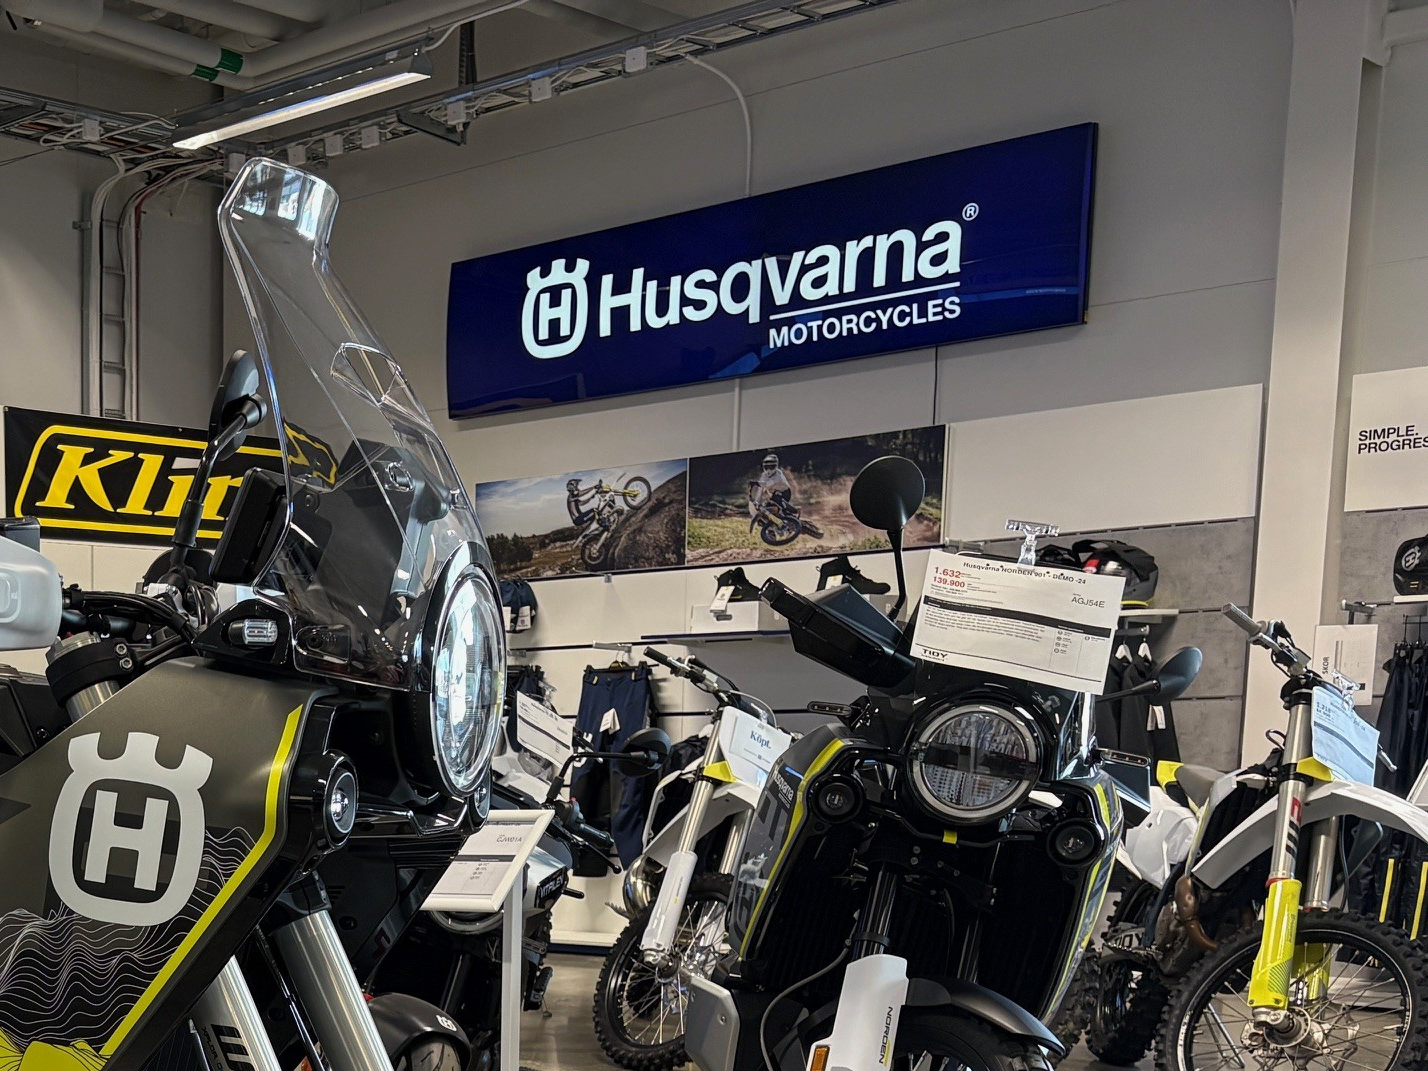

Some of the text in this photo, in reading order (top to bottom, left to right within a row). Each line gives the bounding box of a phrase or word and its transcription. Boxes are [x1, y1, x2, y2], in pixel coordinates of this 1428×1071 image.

[598, 219, 963, 337] Husqvarna
[769, 296, 962, 348] MOTORCYCLES
[1358, 424, 1419, 442] SIMPLE.
[934, 566, 962, 579] 1.632
[963, 561, 1001, 573] Husqvarna
[1001, 567, 1033, 577] NORDEN
[1052, 573, 1075, 583] DEMO
[933, 576, 966, 588] 139.900
[1071, 595, 1106, 609] AGJ54E
[1322, 656, 1330, 675] SKOR
[878, 1006, 893, 1064] NORDEN
